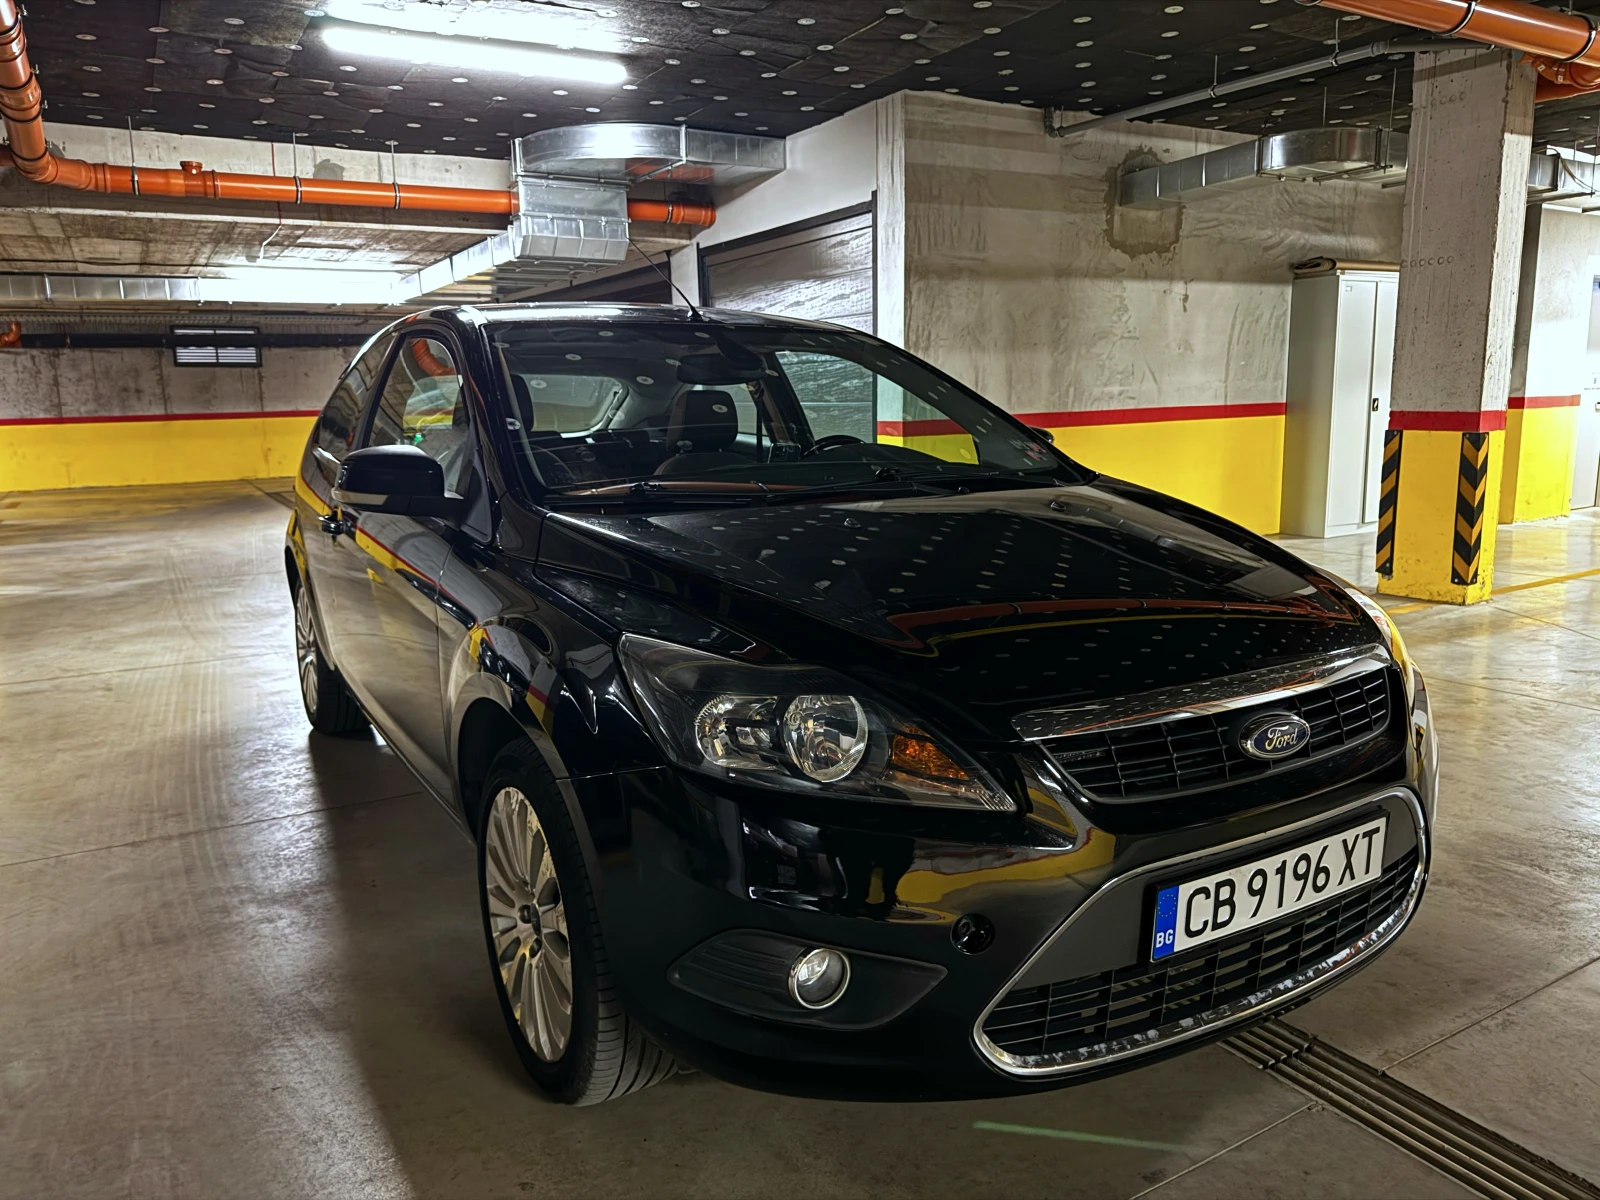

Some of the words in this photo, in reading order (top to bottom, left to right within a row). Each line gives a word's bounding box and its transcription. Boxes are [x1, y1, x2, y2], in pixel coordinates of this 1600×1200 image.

[1265, 725, 1299, 750] Ford
[1184, 878, 1237, 939] CB
[1247, 844, 1331, 919] 9196
[1337, 826, 1381, 887] XT
[1155, 928, 1174, 949] BG
